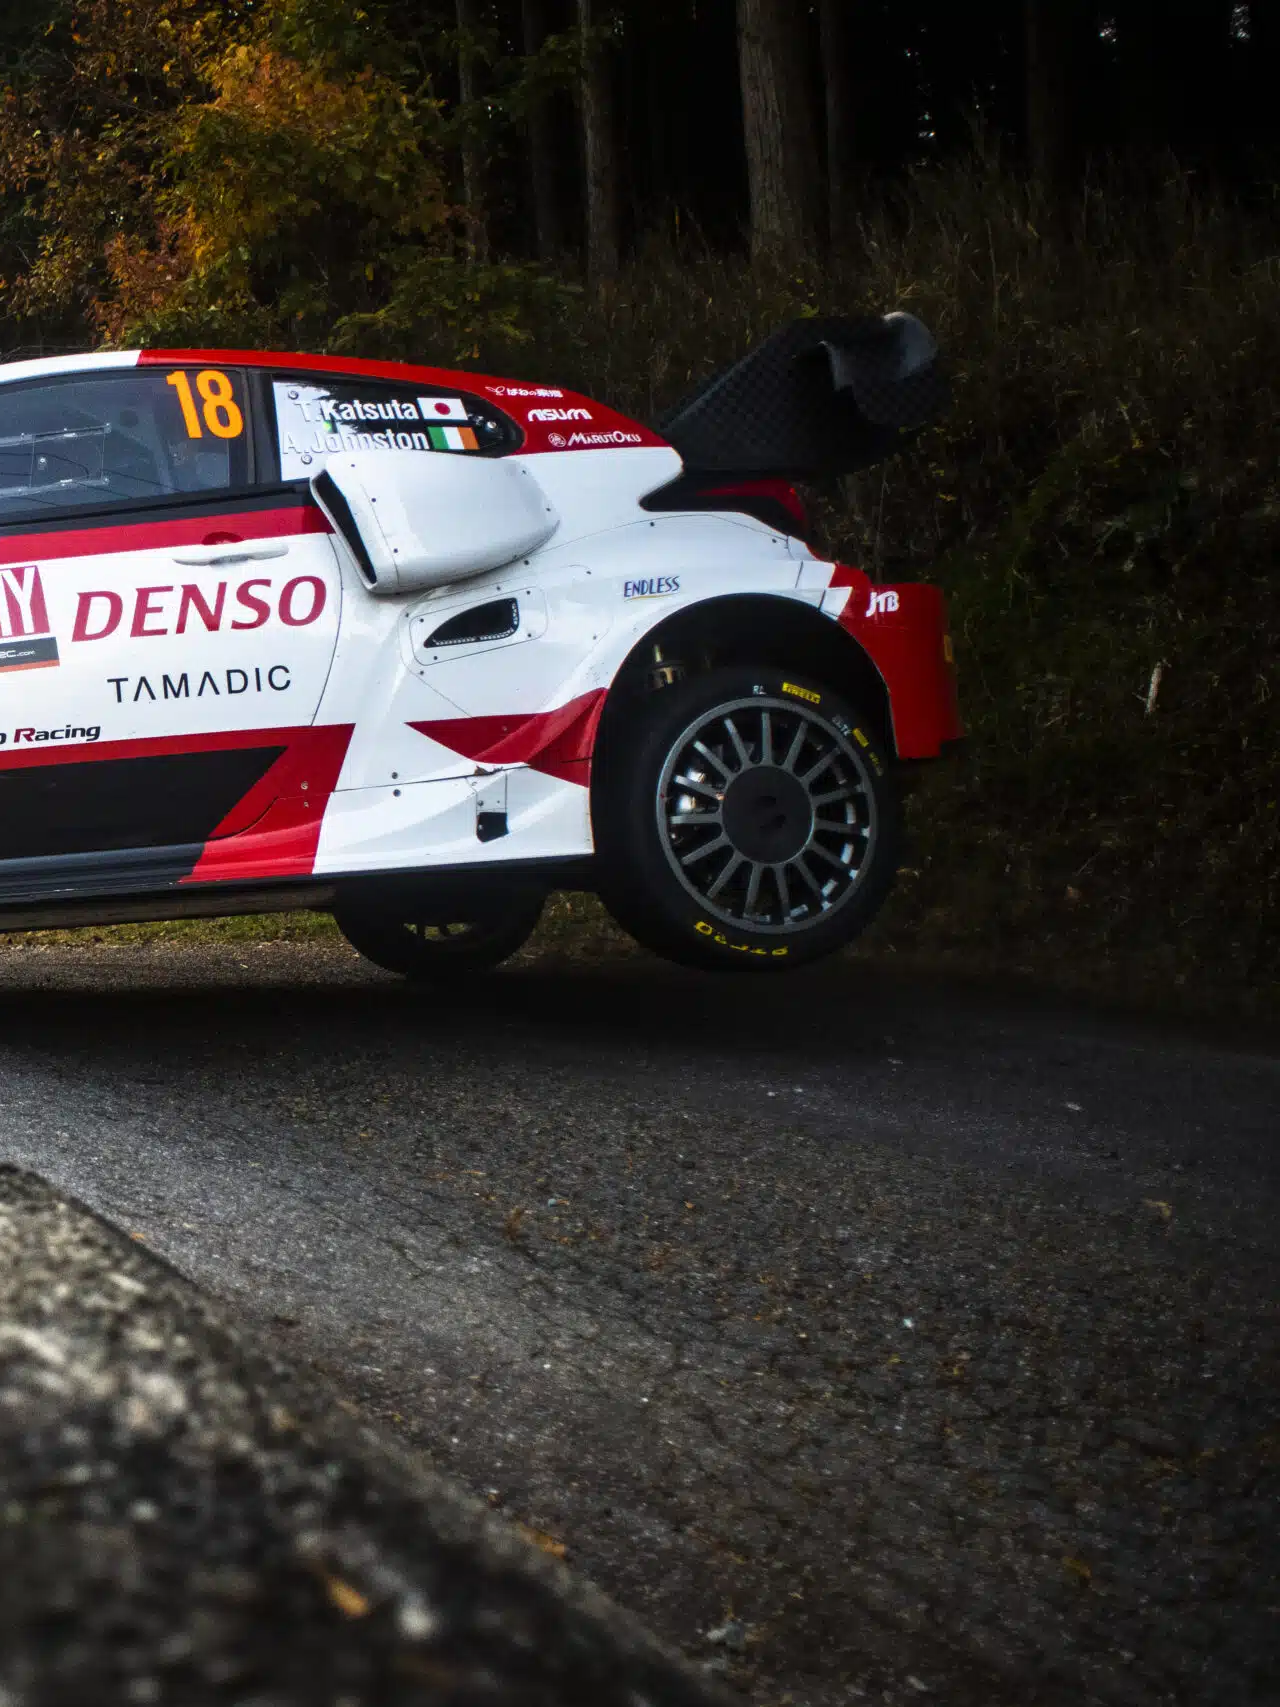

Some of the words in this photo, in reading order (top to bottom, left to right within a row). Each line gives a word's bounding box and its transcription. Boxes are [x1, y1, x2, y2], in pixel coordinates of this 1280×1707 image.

[166, 370, 244, 439] 18
[623, 576, 681, 597] ENDLESS
[72, 575, 328, 643] DENSO
[14, 724, 102, 744] Racing
